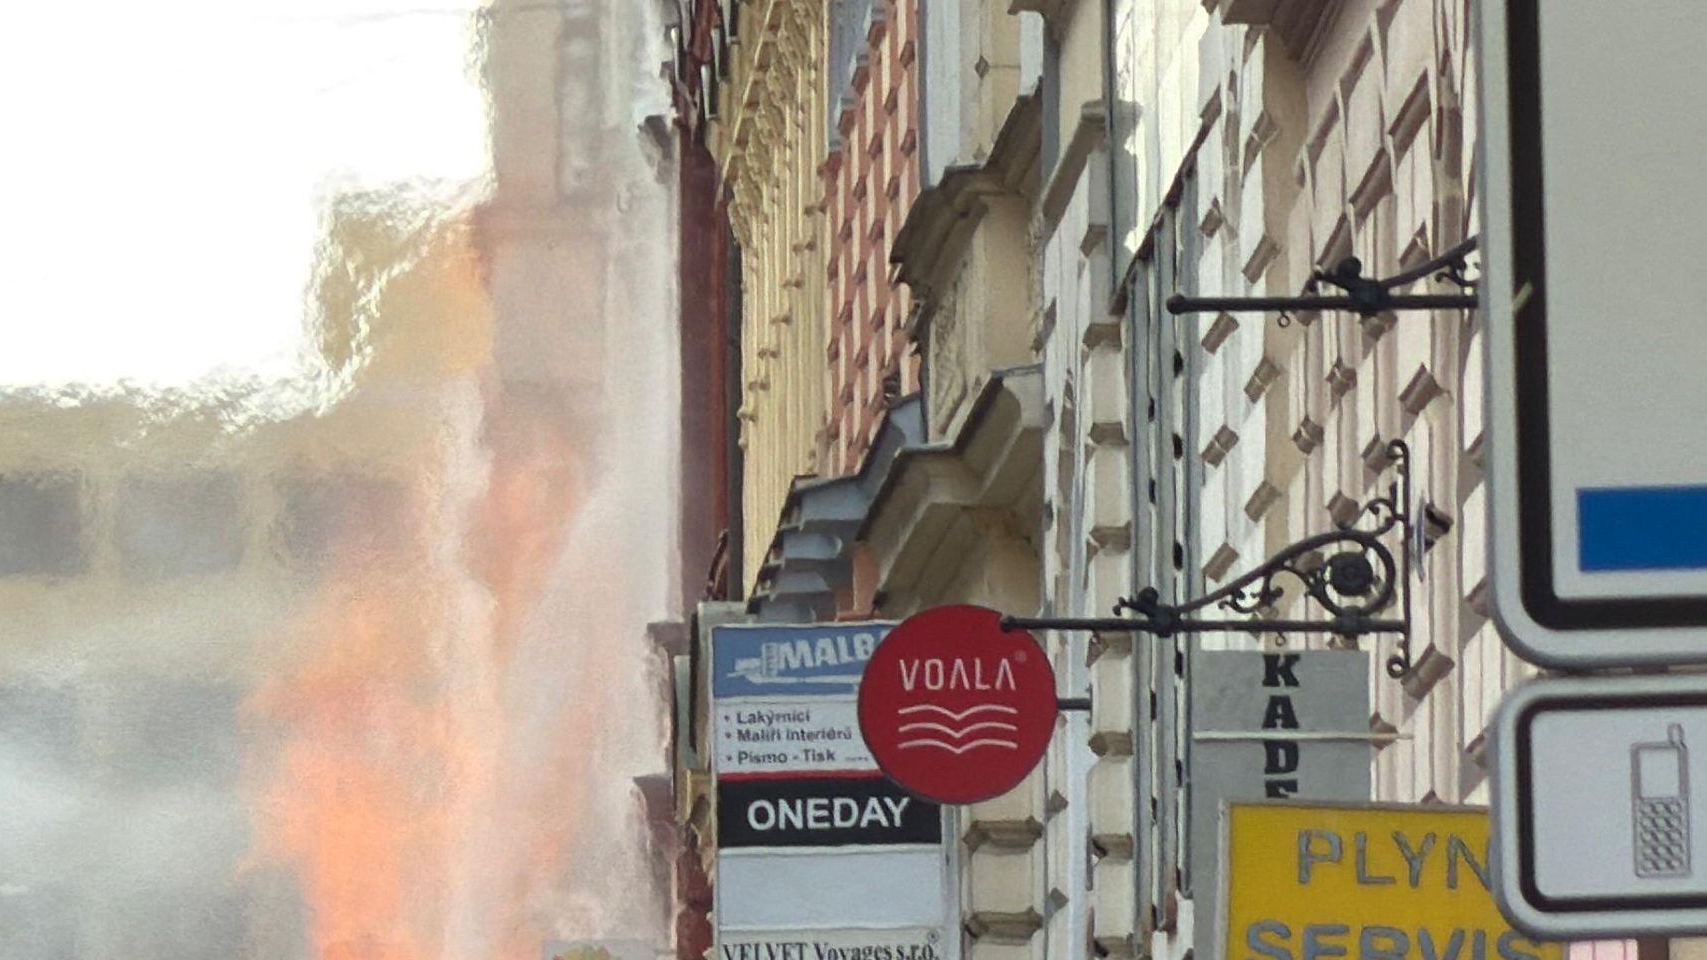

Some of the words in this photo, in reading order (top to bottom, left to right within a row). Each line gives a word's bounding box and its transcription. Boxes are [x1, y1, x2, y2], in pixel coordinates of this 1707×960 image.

[778, 629, 892, 670] MALB
[898, 657, 1016, 691] VOALA
[803, 748, 837, 762] Tisk
[747, 797, 910, 831] ONEDAY
